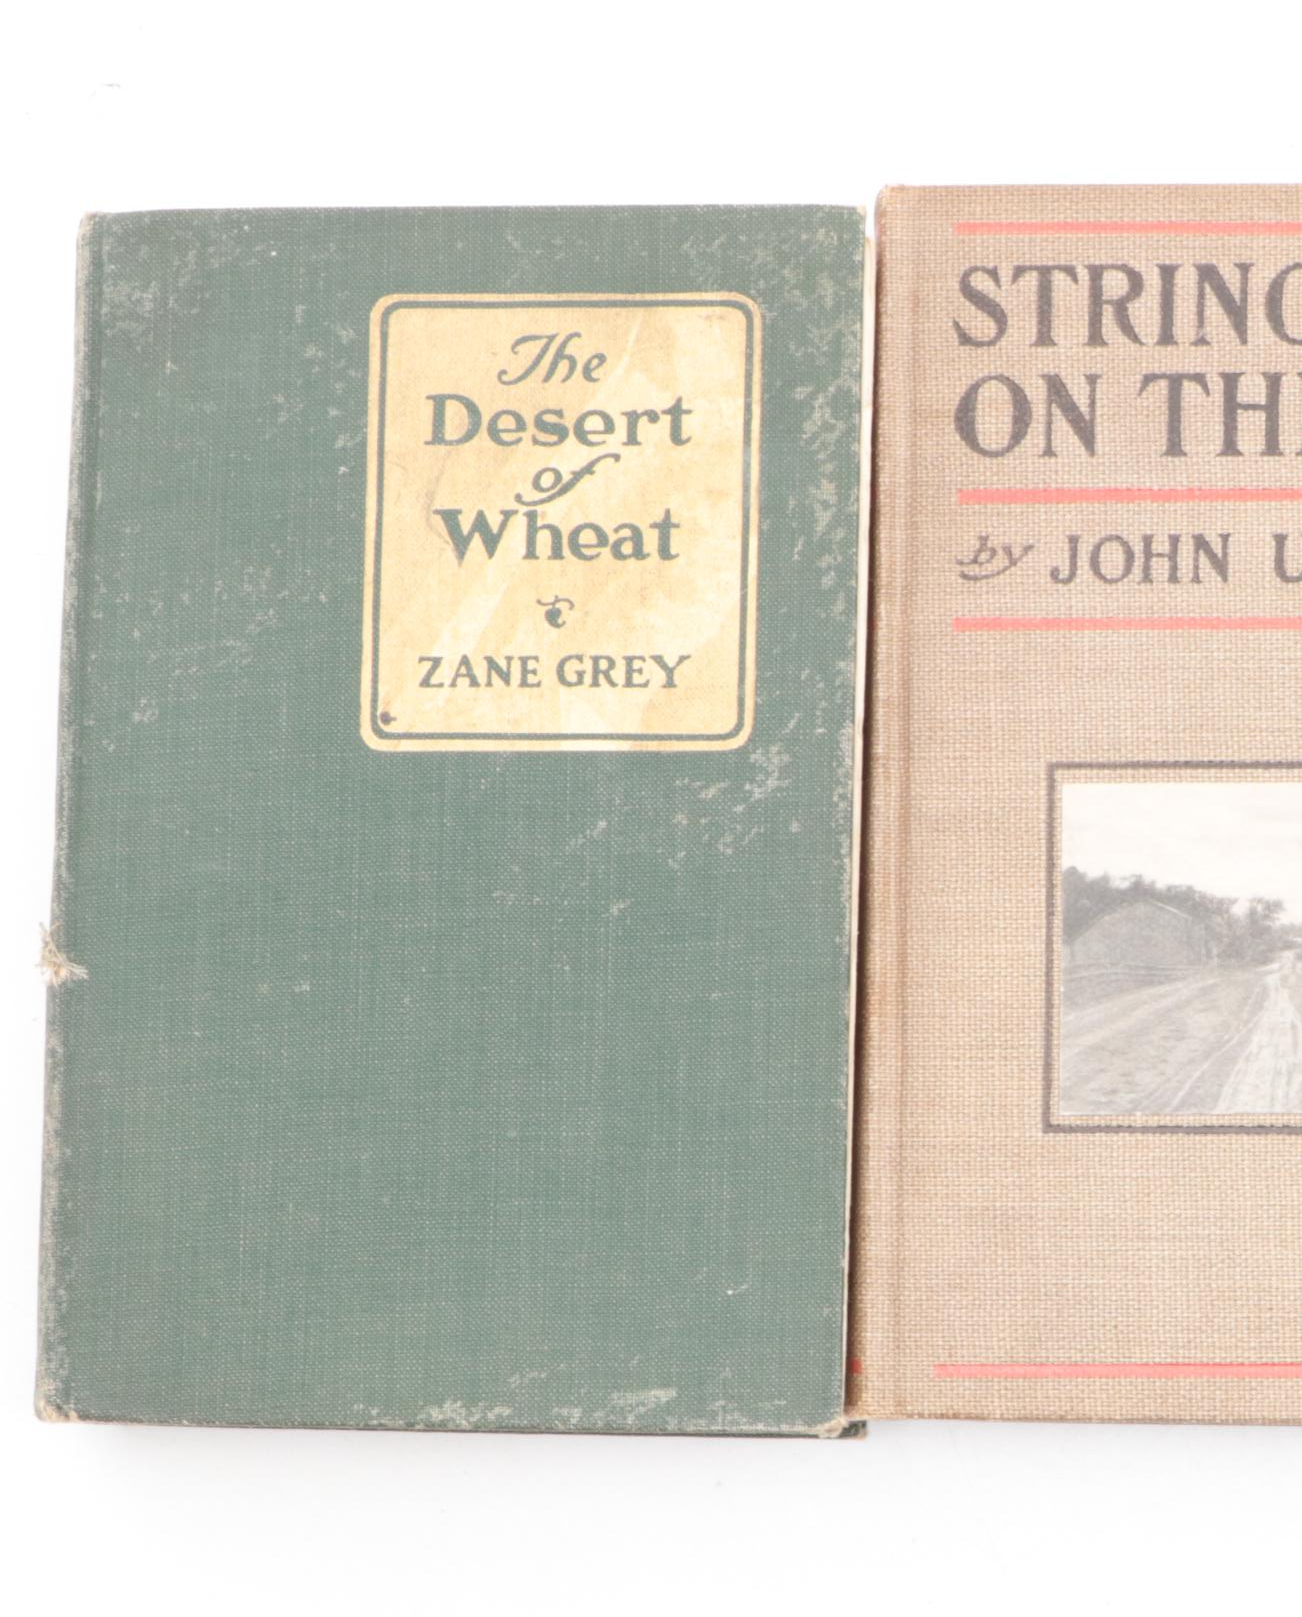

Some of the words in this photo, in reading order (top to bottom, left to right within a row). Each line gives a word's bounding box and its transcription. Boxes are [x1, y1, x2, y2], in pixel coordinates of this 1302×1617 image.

[497, 331, 608, 385] The
[423, 393, 693, 447] Desert
[953, 373, 1102, 458] ON
[514, 452, 621, 507] of
[432, 507, 681, 568] Wheat
[954, 534, 1036, 581] by
[1049, 532, 1232, 585] JOHN
[418, 655, 542, 689] ZANE
[555, 653, 692, 690] GREY
